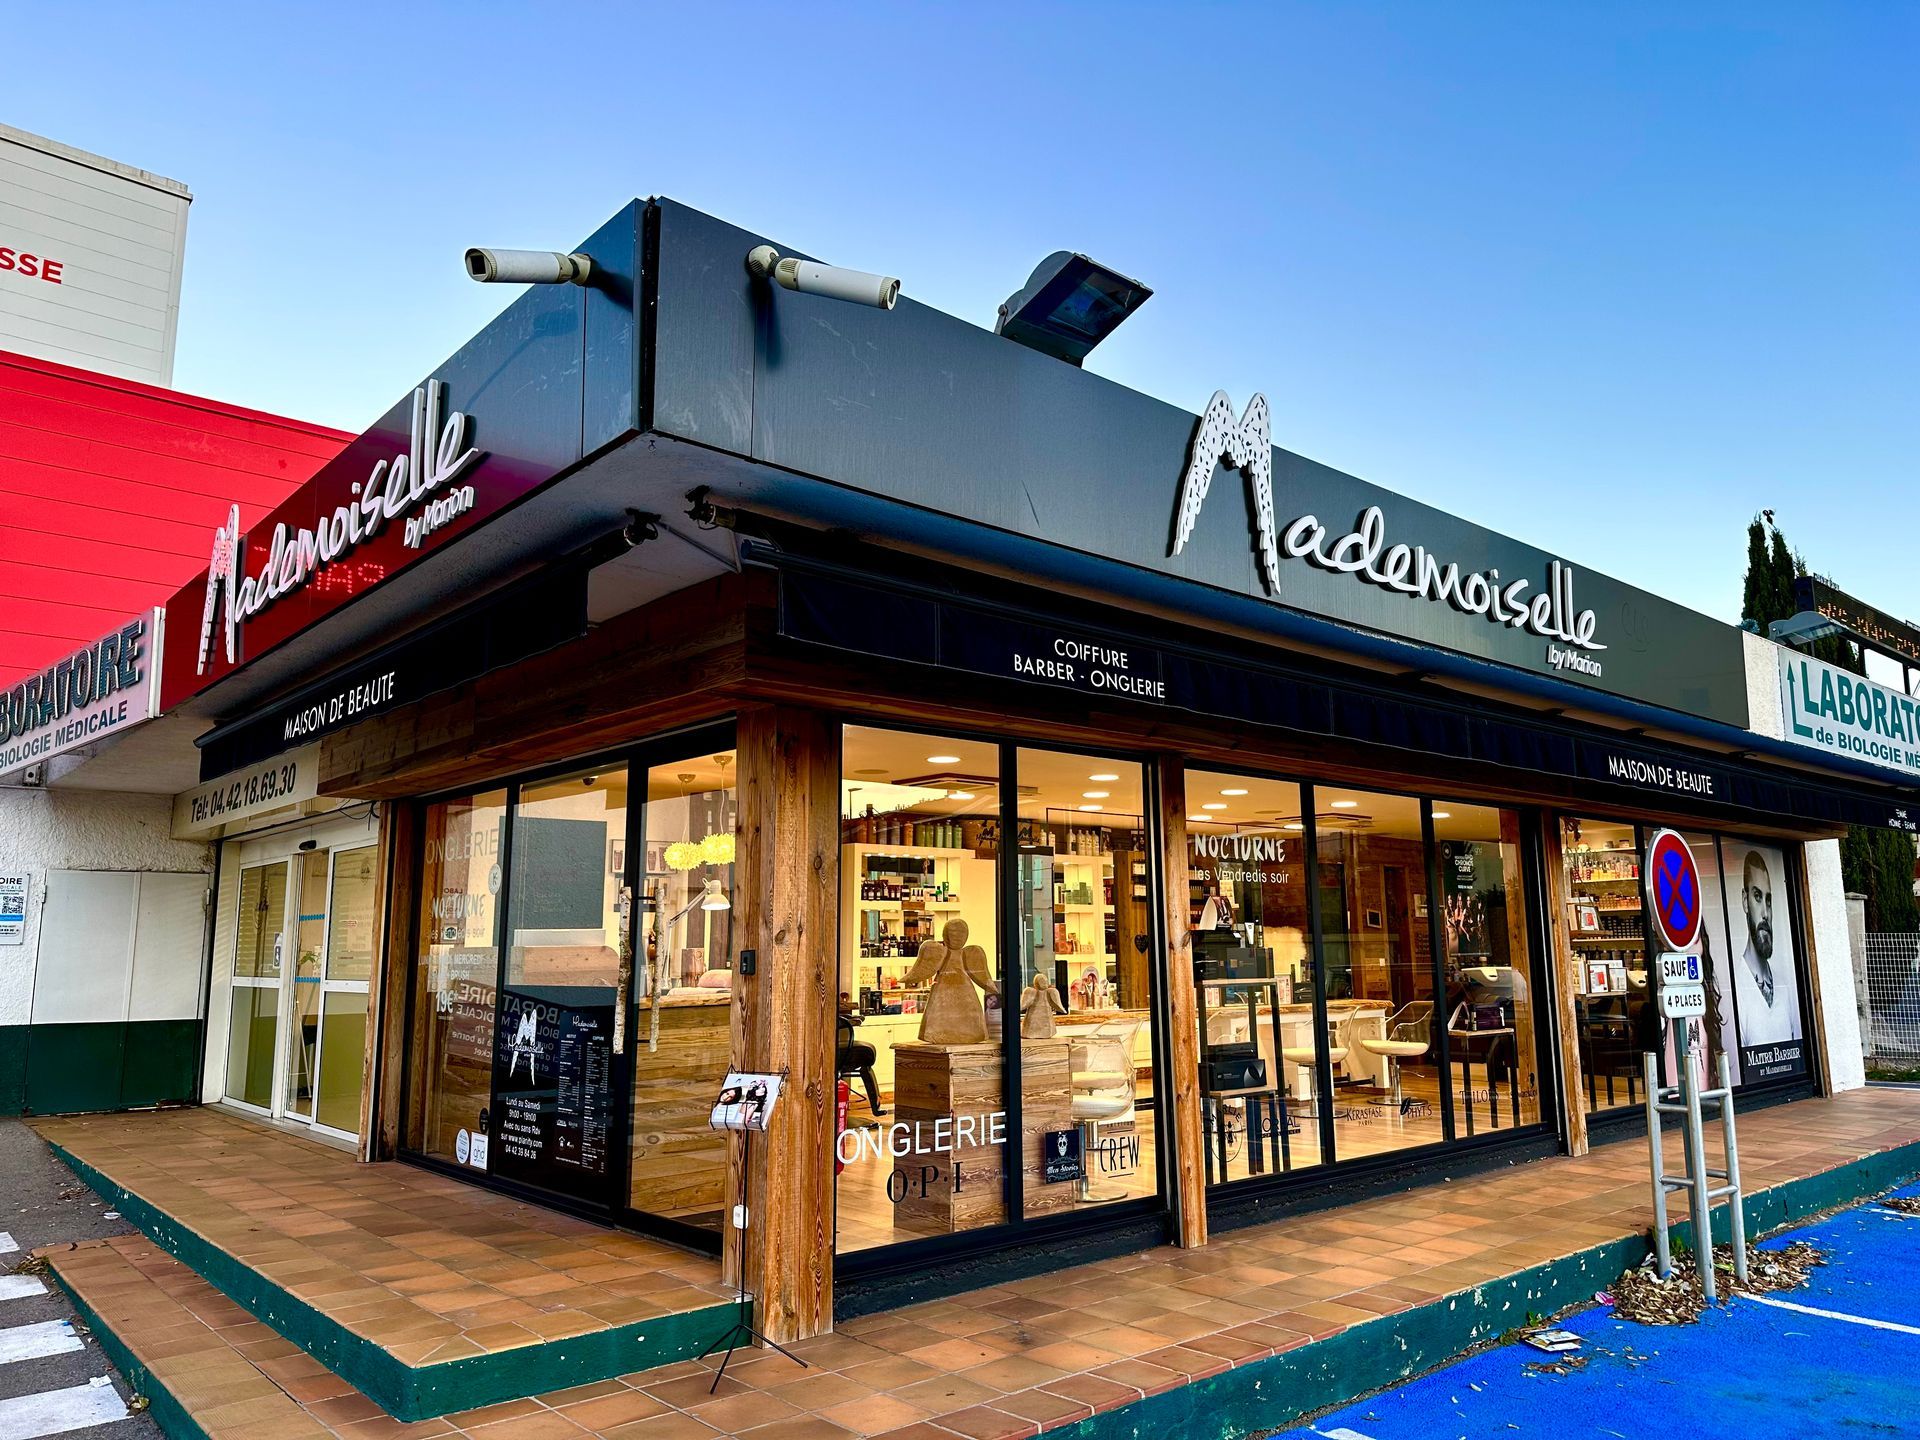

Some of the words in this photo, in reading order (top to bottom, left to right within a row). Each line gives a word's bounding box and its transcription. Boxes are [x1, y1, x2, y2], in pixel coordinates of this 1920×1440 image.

[197, 378, 478, 675] Mademoiselle
[404, 517, 424, 549] by
[422, 486, 474, 535] Marion
[1173, 389, 1607, 650] Mademoiselle
[1054, 638, 1129, 669] COIFFURE
[1548, 644, 1565, 669] by
[1563, 649, 1602, 677] Marion
[1014, 653, 1075, 681] BARBER
[1090, 670, 1166, 698] ONGLERIE
[55, 699, 128, 748] MÉDICALE
[284, 701, 327, 741] MAISON
[329, 693, 345, 724] DE
[347, 671, 396, 715] BEAUTE
[1816, 726, 1834, 746] de
[1838, 731, 1902, 764] BIOLOGIE
[191, 797, 209, 823] Tél:
[210, 762, 297, 818] 04.42.18.69.30
[1608, 754, 1657, 784] MAISON
[1658, 766, 1674, 787] DE
[1676, 769, 1714, 794] BEAUTE
[425, 828, 499, 864] ONGLERIE
[1194, 832, 1286, 863] NOCTURNE
[1194, 866, 1211, 881] les
[1214, 866, 1267, 884] Vendredis
[1270, 870, 1290, 884] soir
[1664, 960, 1687, 978] SAUF
[1667, 994, 1673, 1008] 4
[1675, 993, 1703, 1008] PLACES
[524, 1099, 541, 1111] Samedi
[1346, 1106, 1383, 1121] KÉRASTASE
[836, 1111, 1008, 1165] ONGLERIE
[1099, 1134, 1140, 1173] CREW
